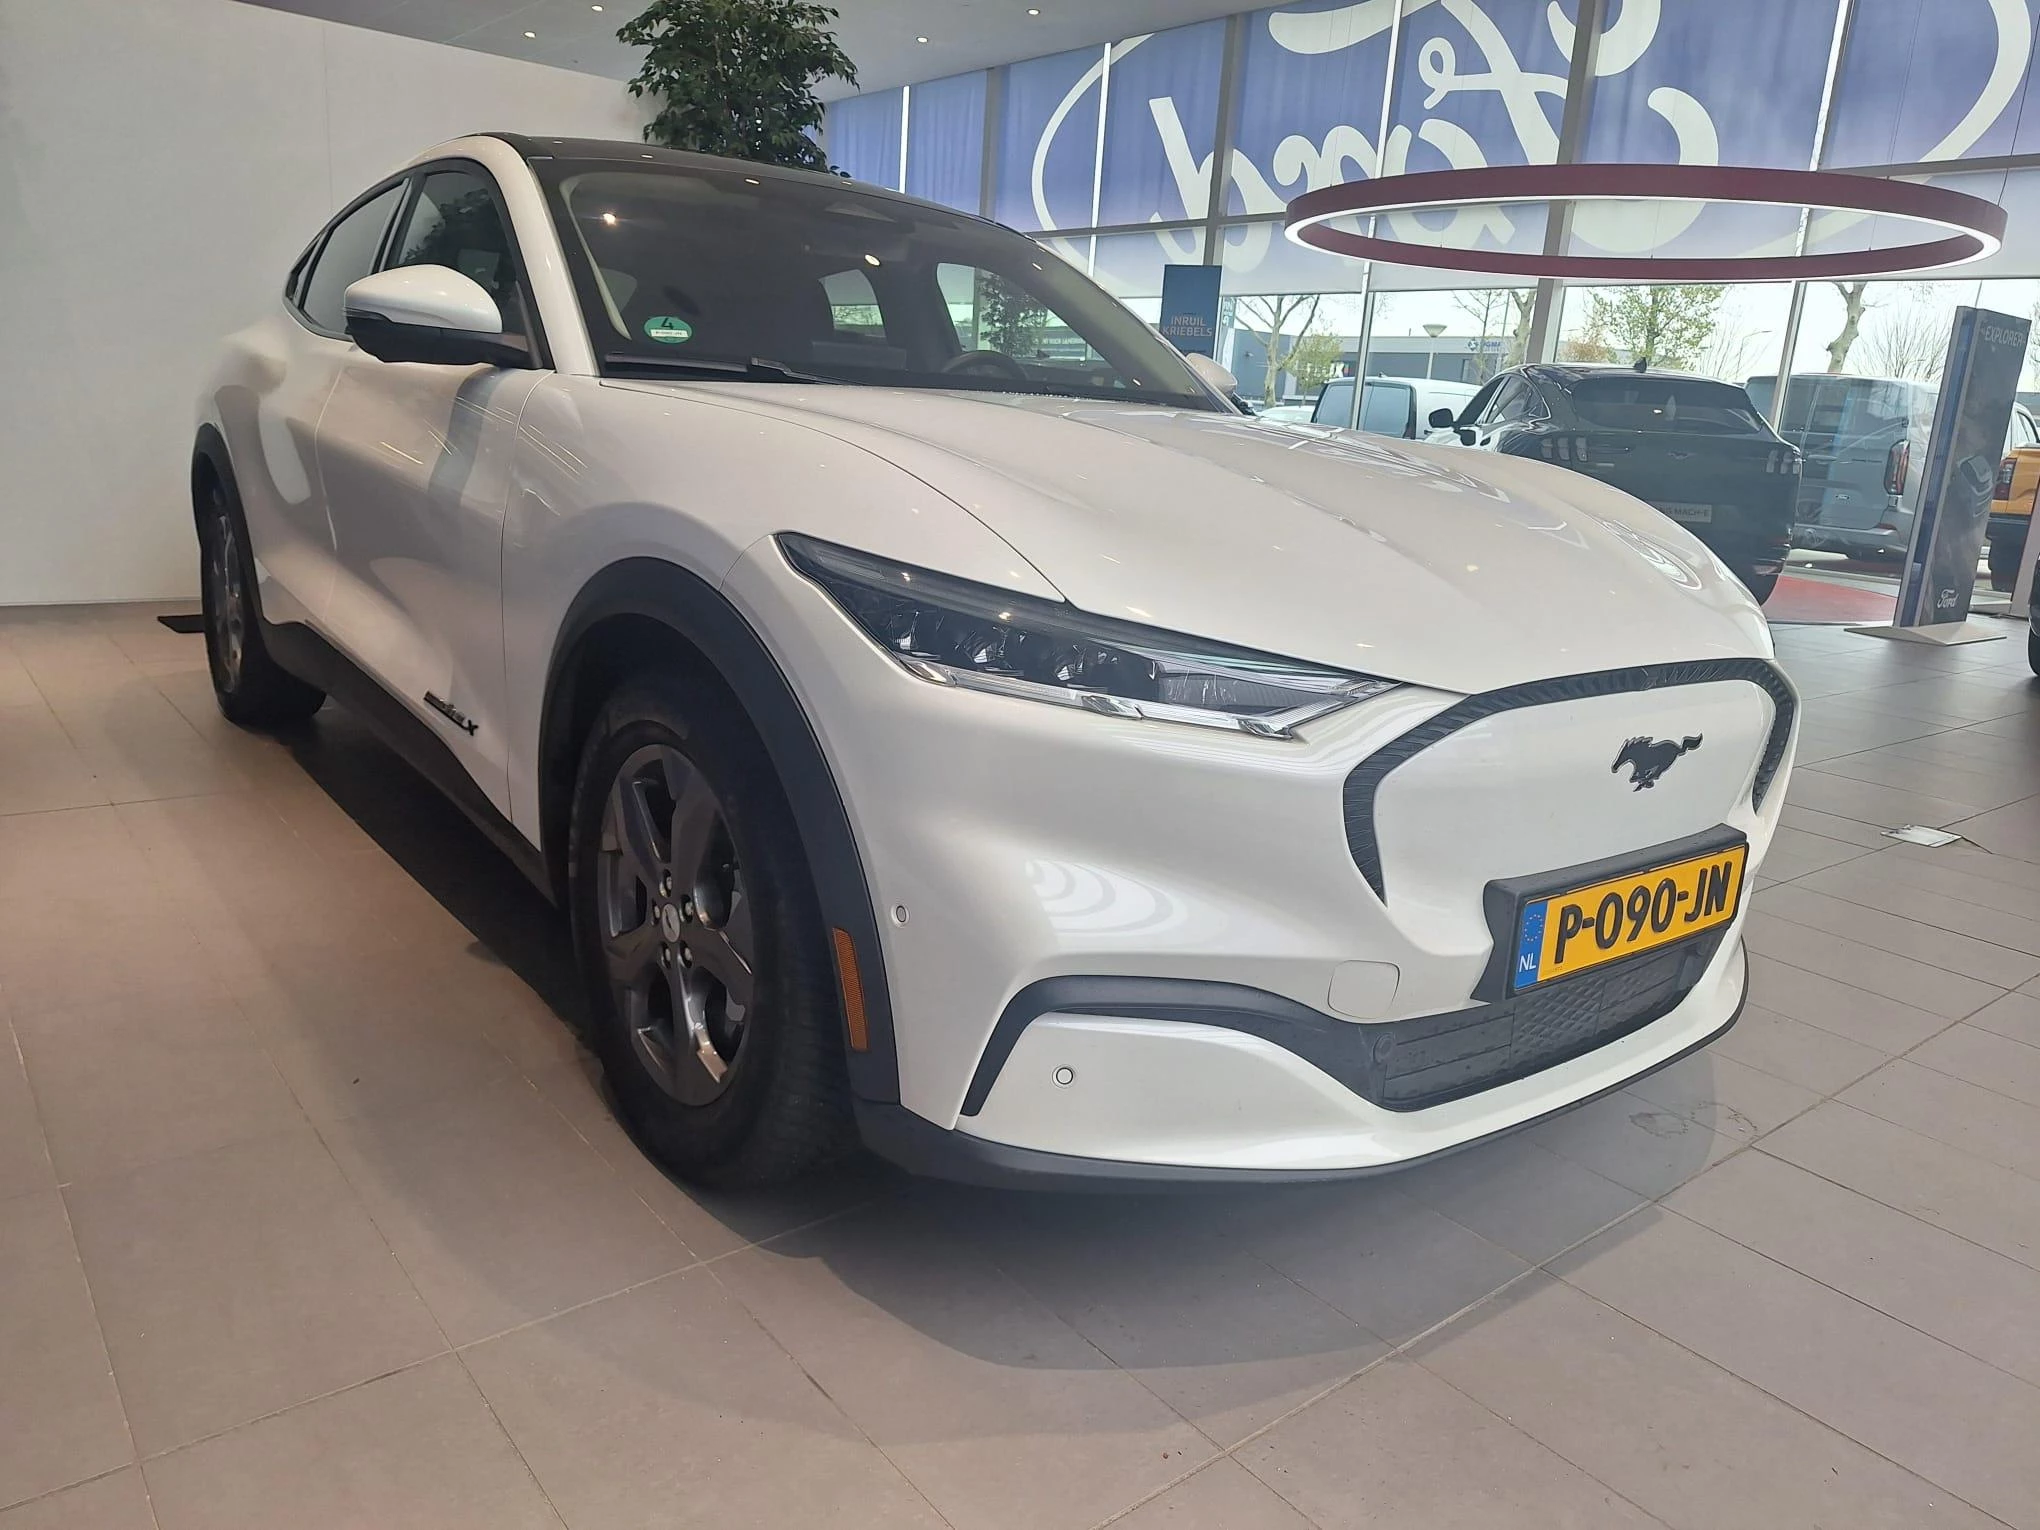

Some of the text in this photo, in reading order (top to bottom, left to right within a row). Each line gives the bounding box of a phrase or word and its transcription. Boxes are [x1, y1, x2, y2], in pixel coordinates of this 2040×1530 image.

[661, 317, 673, 330] 4
[1162, 326, 1213, 337] KRIEBELS
[1171, 316, 1207, 327] INRUIL
[1985, 325, 2023, 347] EXPLORER
[1936, 588, 1960, 609] Ford
[1554, 861, 1733, 964] P-090-JN
[1518, 952, 1537, 973] NL
